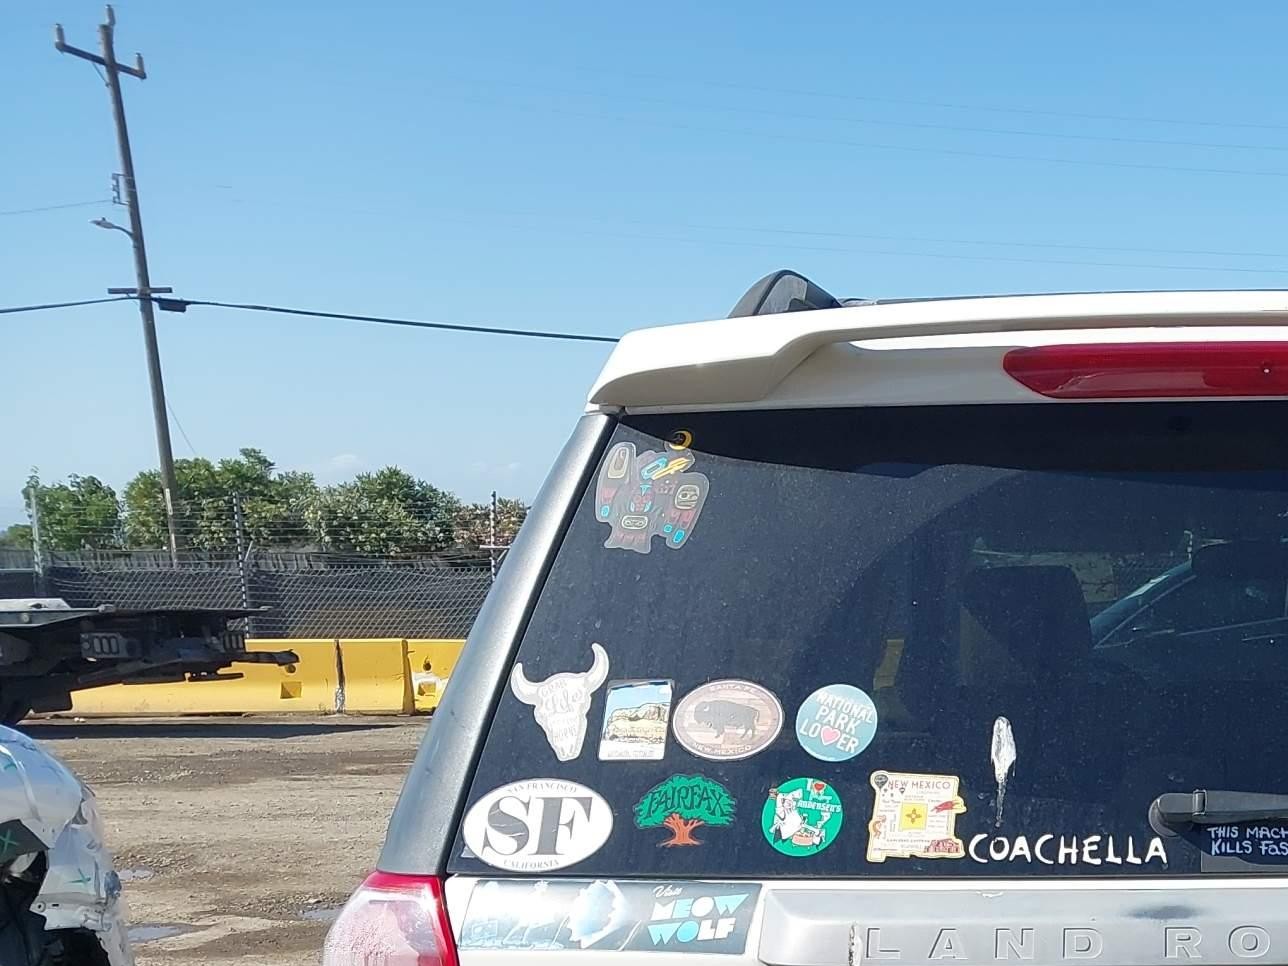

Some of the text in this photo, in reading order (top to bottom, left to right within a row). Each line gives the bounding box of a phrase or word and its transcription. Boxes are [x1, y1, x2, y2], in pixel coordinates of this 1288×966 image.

[815, 706, 861, 735] PARK
[816, 690, 875, 723] NATIONAL
[714, 744, 753, 755] MEXICO
[526, 782, 577, 794] FRANCISCO
[887, 779, 951, 791] NEW MEXICO
[644, 784, 728, 820] FAIRFAX
[481, 795, 593, 856] SF
[1206, 825, 1239, 839] THIS
[968, 832, 1168, 867] COACHELLA
[1210, 838, 1253, 856] KILLS
[503, 858, 560, 870] CALIFORNIA
[650, 893, 750, 921] MEOW
[647, 917, 736, 946] WOLF
[865, 926, 1104, 961] LAND
